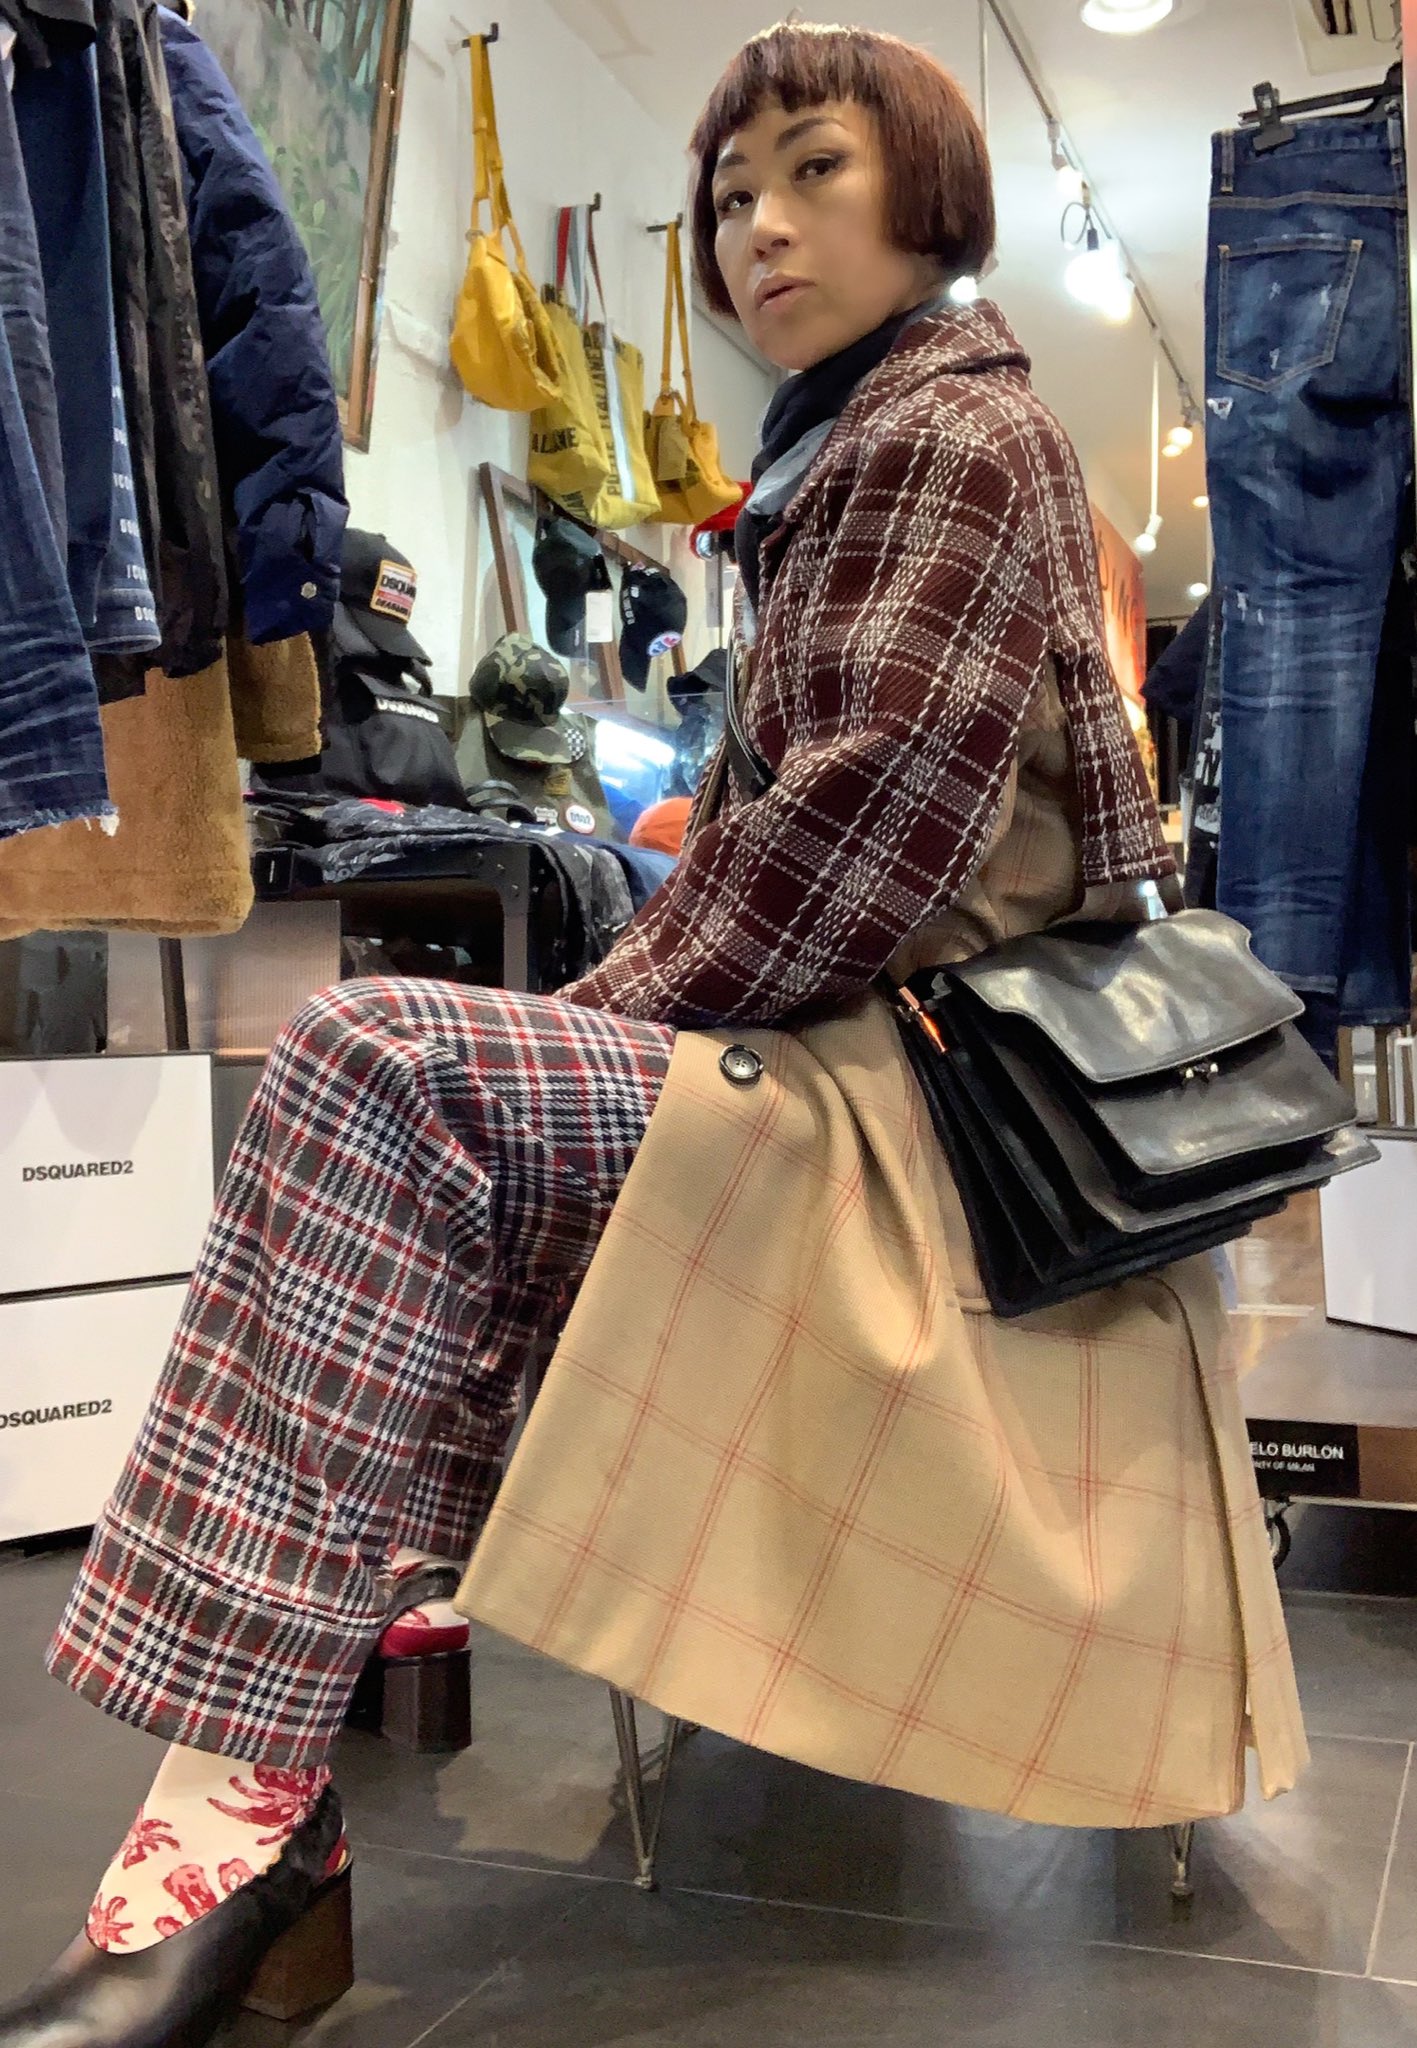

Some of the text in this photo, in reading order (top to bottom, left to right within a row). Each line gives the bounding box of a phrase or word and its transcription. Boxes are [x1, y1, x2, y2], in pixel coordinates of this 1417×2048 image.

[22, 1159, 134, 1182] DSQUARED2
[0, 1398, 112, 1429] DSQUARED2
[1281, 1443, 1344, 1460] BURLON
